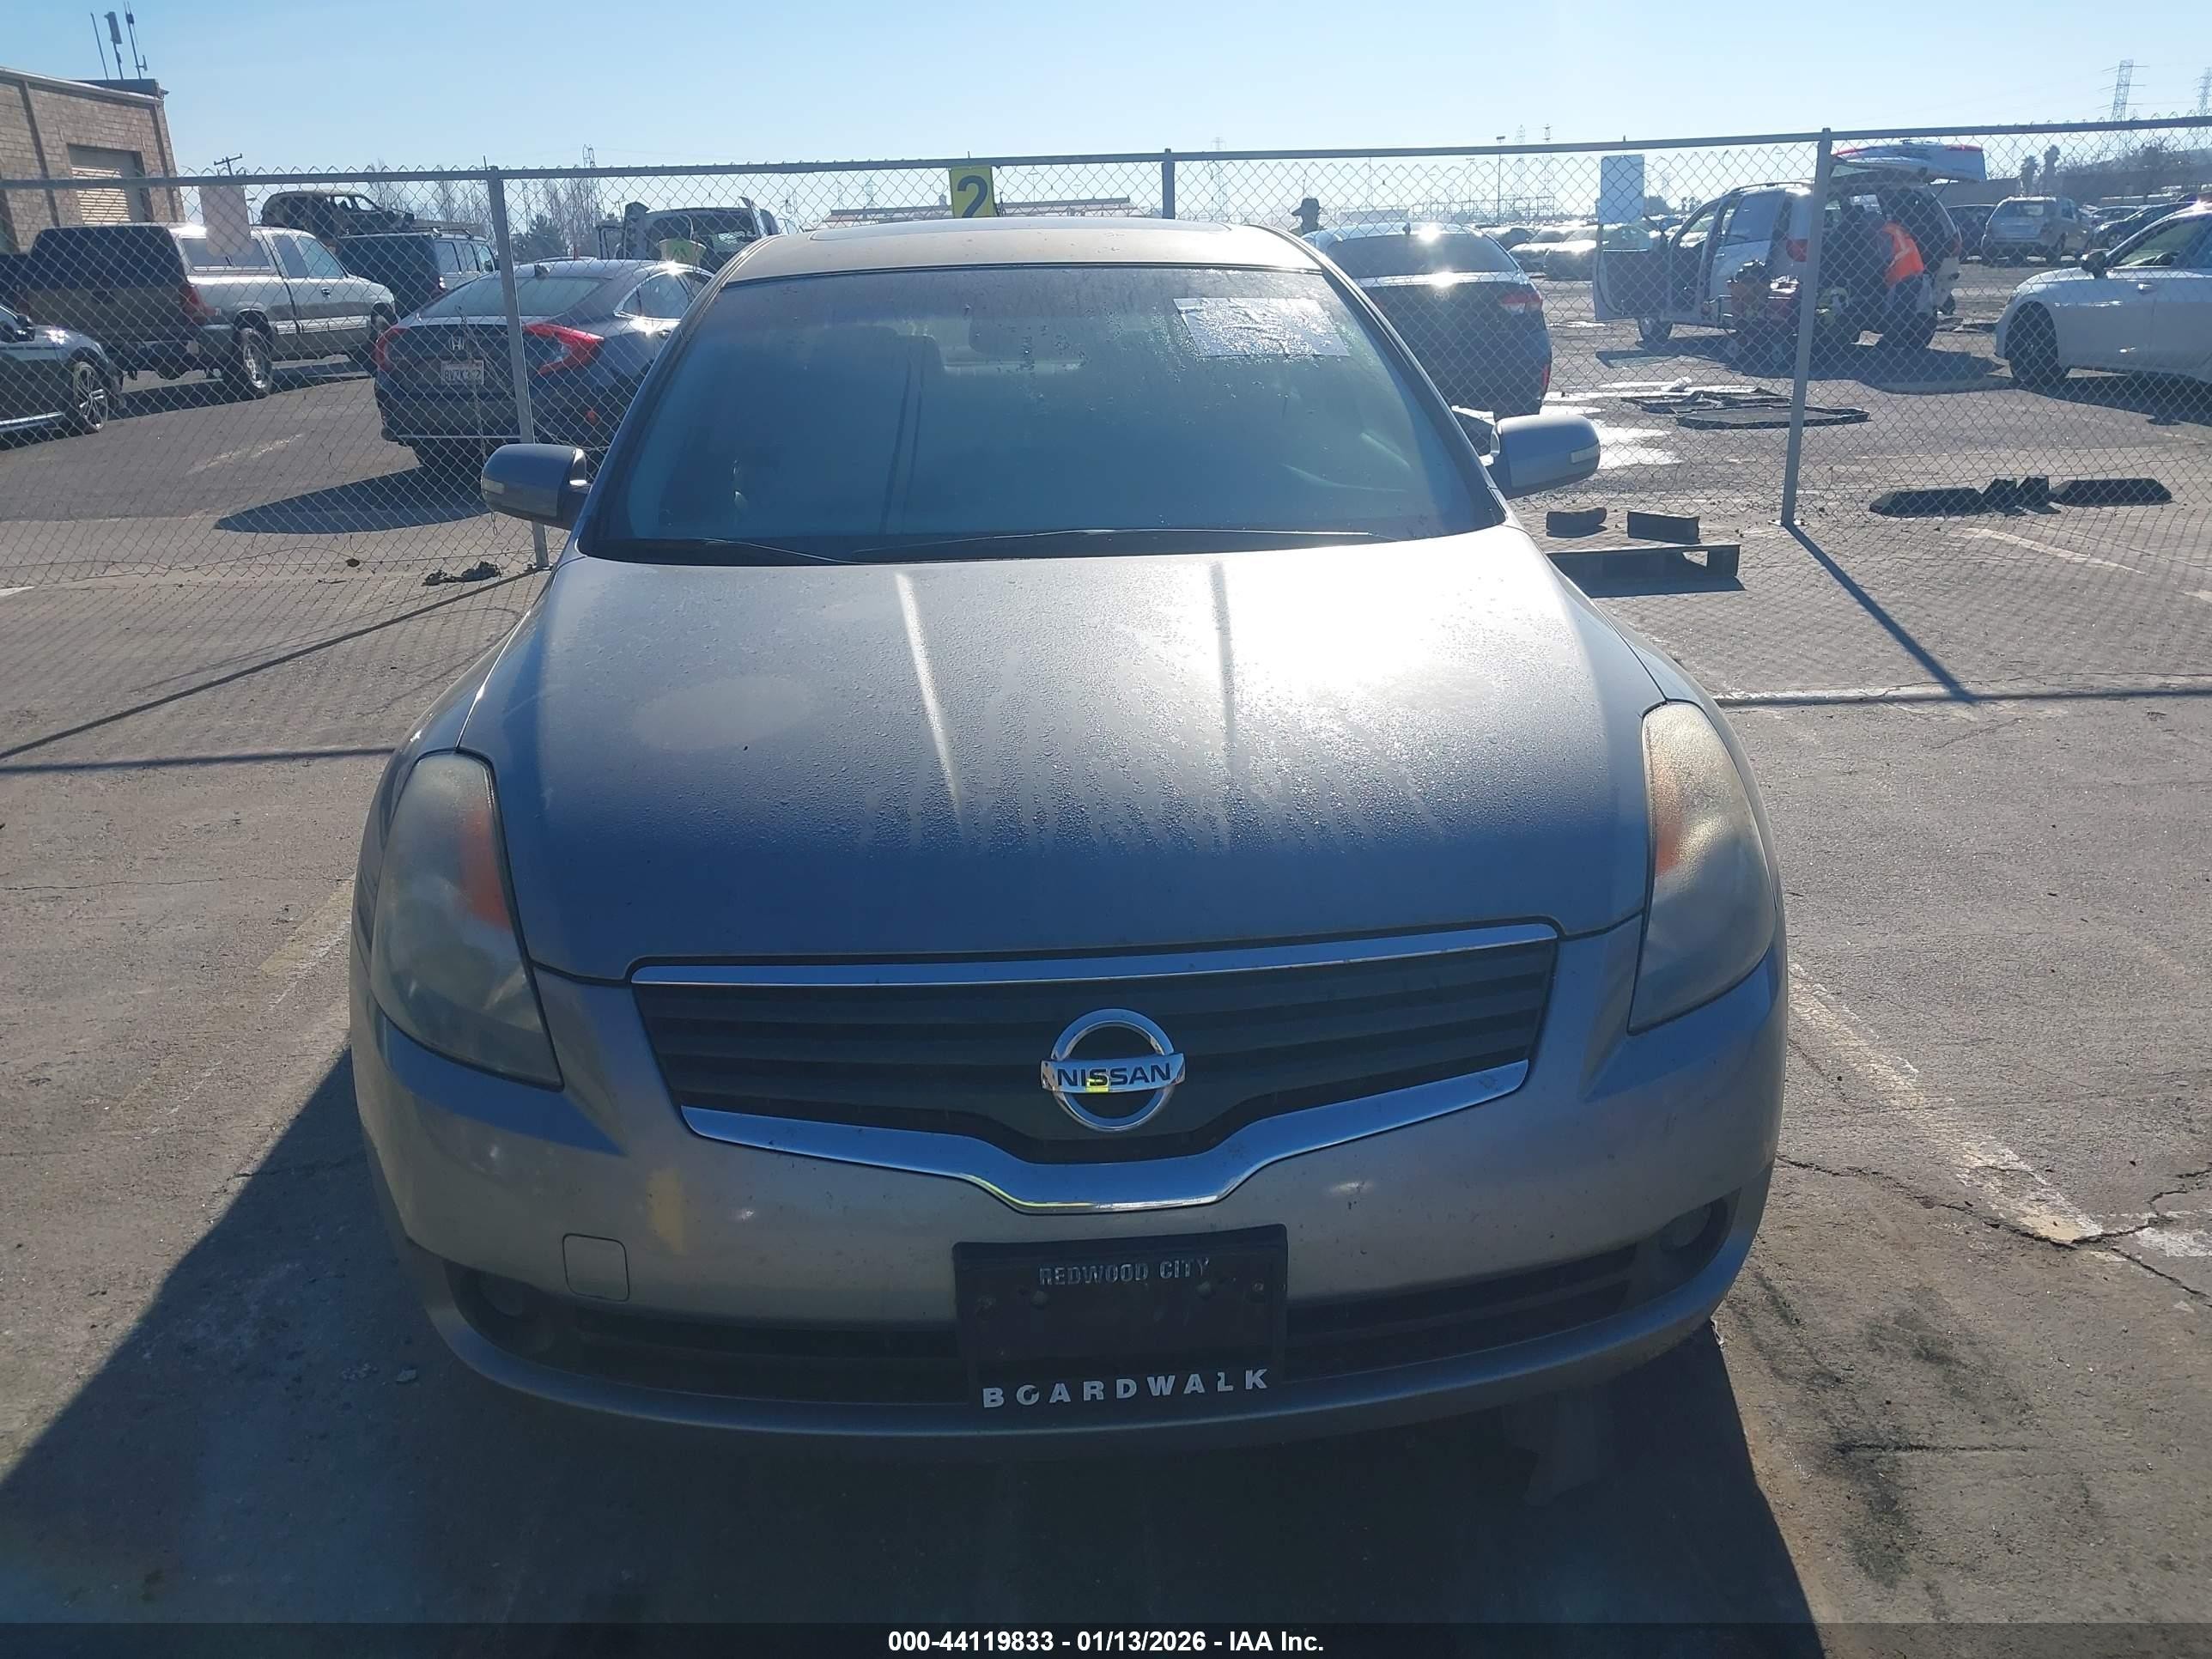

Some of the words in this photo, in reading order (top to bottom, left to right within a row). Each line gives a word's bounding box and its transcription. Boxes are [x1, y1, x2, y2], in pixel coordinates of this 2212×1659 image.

[957, 175, 988, 217] 2
[1057, 1063, 1171, 1087] NISSAN
[1039, 1263, 1149, 1285] REDWOOD
[1159, 1257, 1209, 1279] CITY
[982, 1369, 1267, 1408] BOARDWALK
